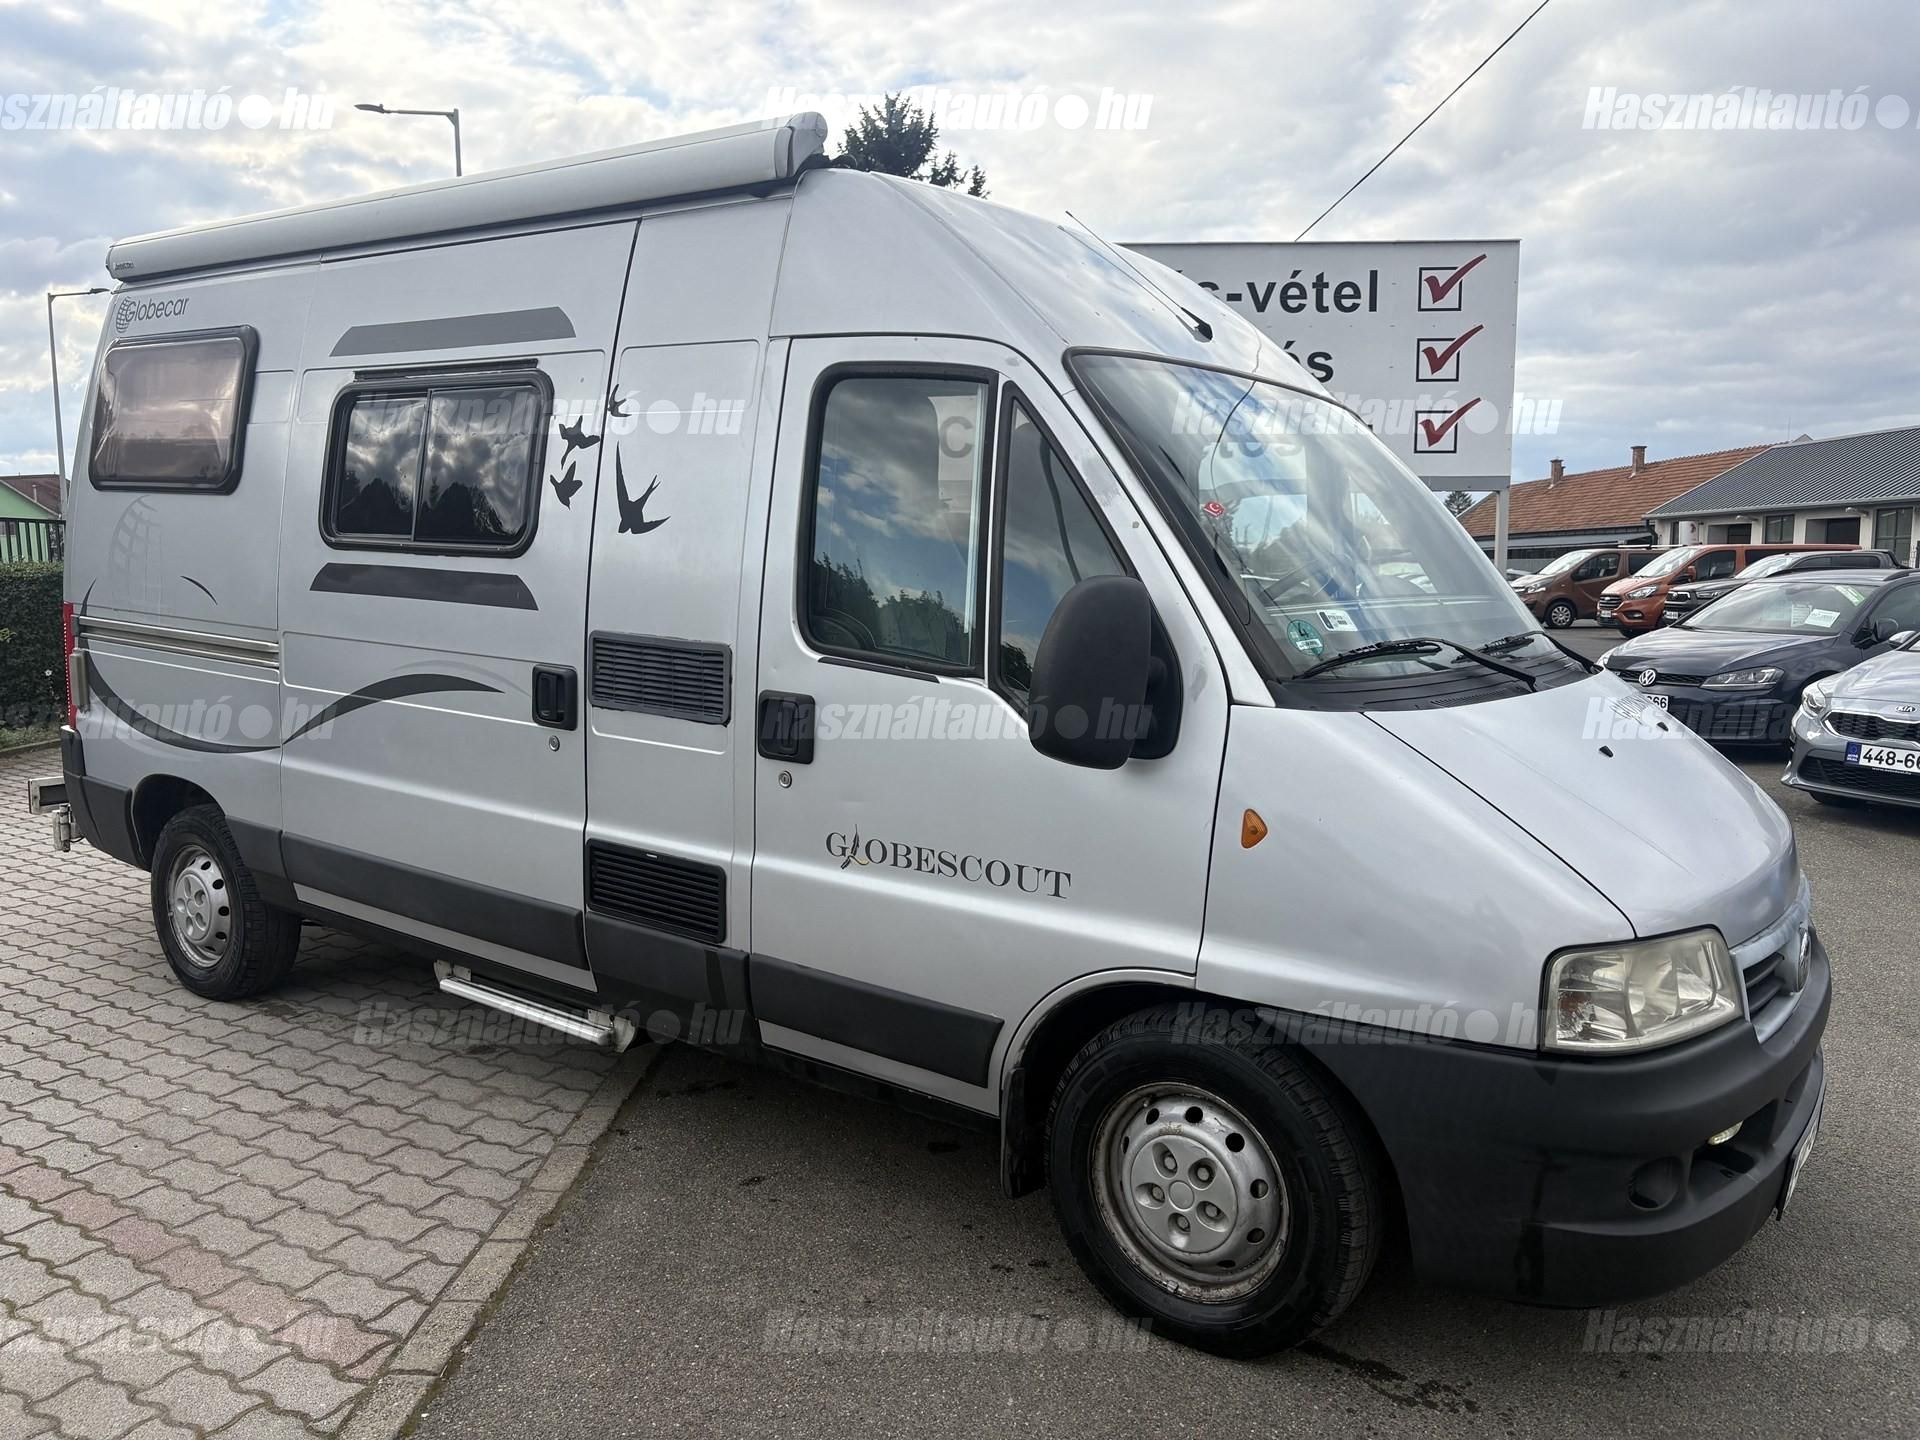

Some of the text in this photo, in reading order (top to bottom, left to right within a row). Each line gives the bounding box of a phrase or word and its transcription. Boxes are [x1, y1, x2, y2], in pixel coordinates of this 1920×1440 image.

[125, 298, 189, 322] Globecar
[1896, 705, 1915, 713] KIA
[825, 824, 1072, 899] GLOBESCOUT
